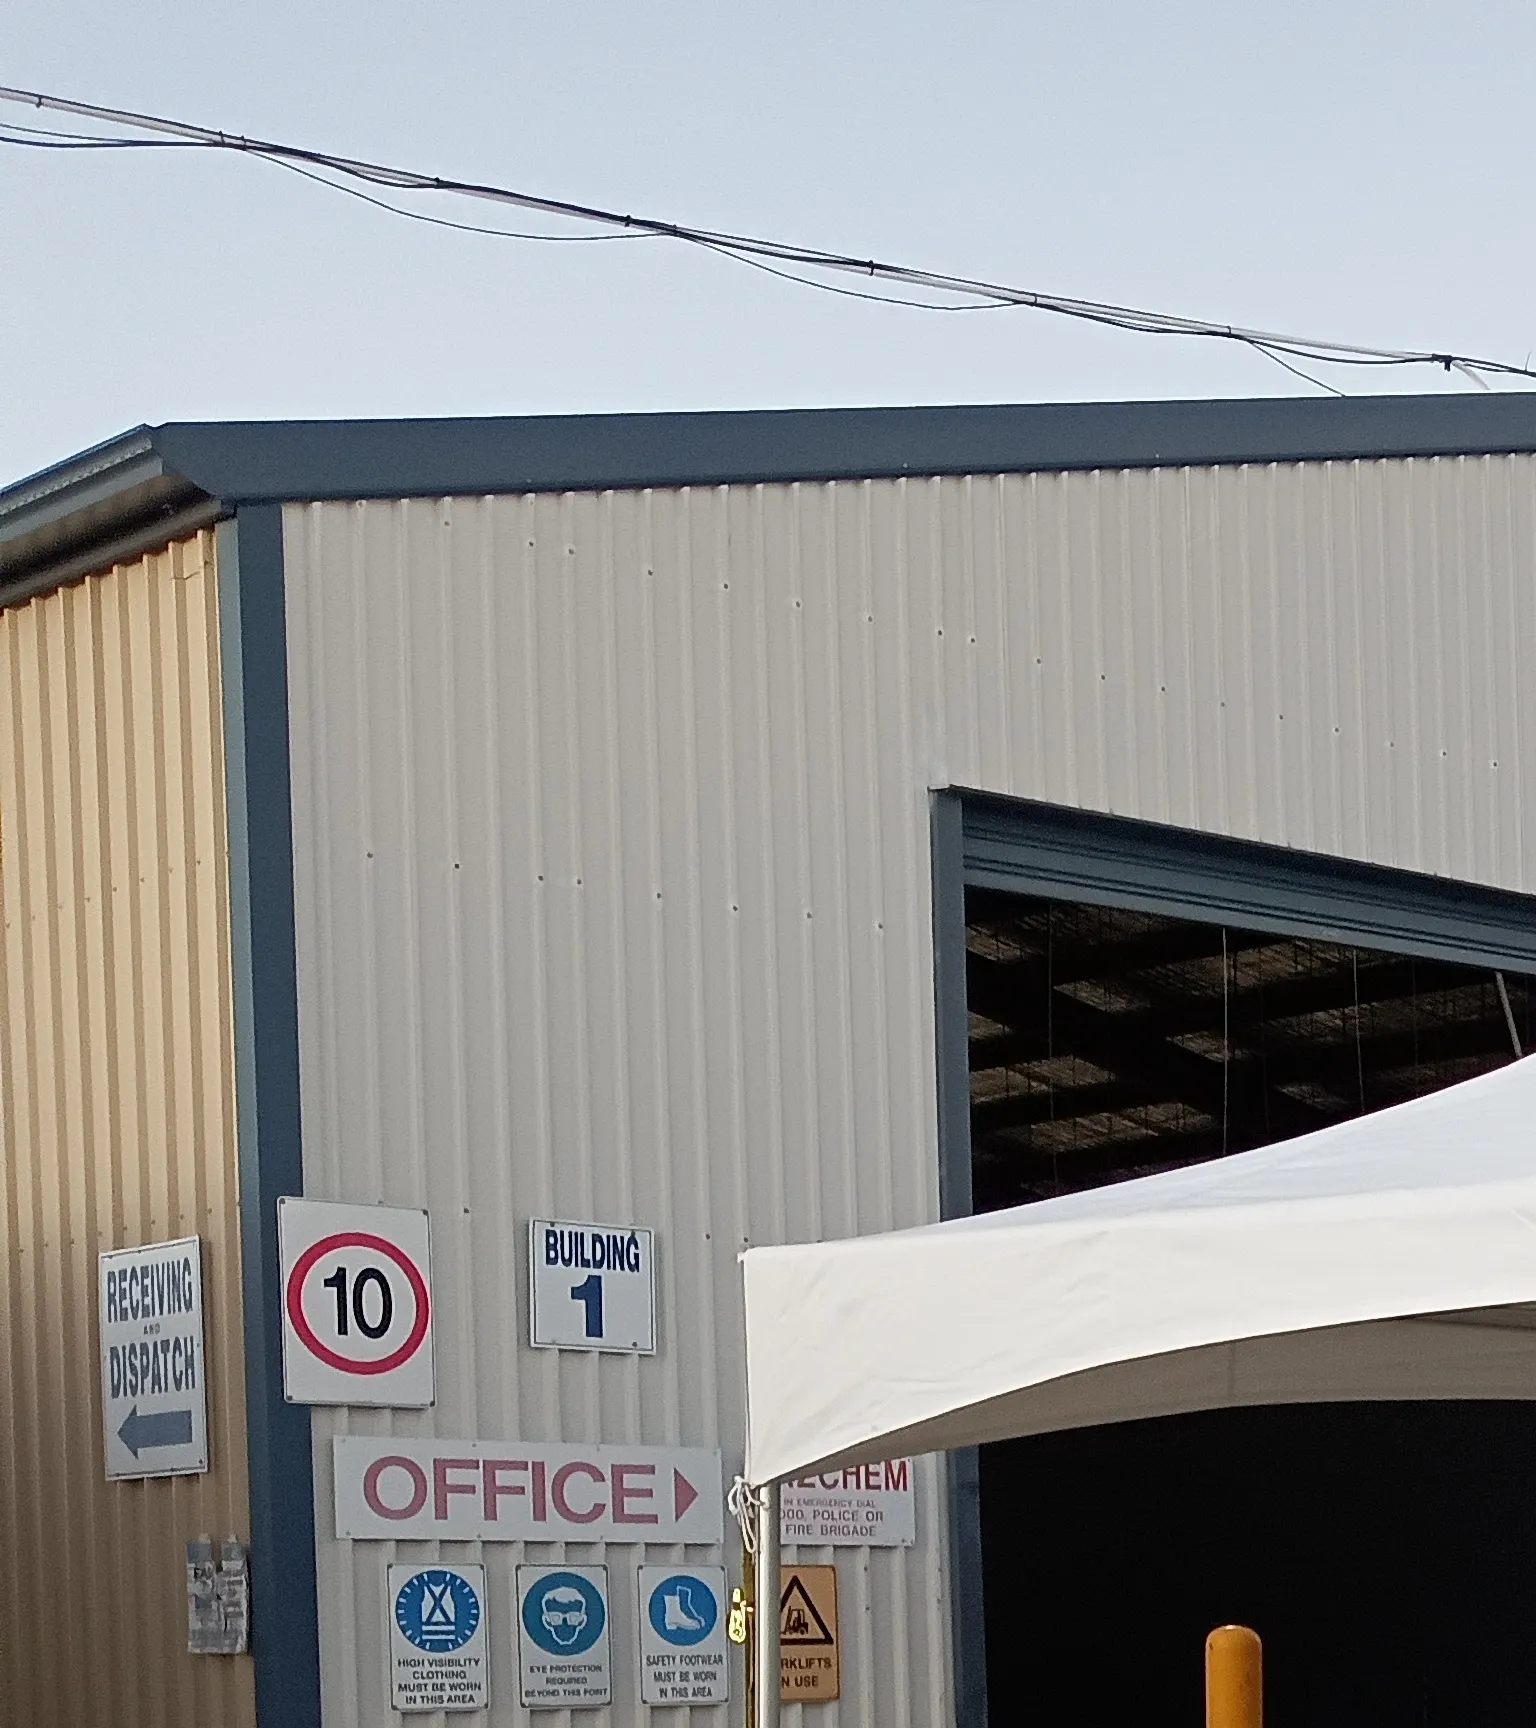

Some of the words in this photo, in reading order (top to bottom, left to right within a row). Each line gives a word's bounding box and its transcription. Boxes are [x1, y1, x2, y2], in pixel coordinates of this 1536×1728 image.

[545, 1229, 640, 1273] BUILDING
[107, 1257, 193, 1323] RECEIVING
[323, 1266, 393, 1339] 10
[570, 1275, 603, 1338] 1
[143, 1322, 161, 1335] AND
[110, 1335, 196, 1399] DISPATCH
[786, 1460, 908, 1492] CHEM
[363, 1455, 659, 1524] OFFICE
[797, 1499, 852, 1507] EMERGENCY
[856, 1500, 876, 1508] DIAL
[813, 1509, 859, 1522] POLICE
[866, 1511, 883, 1522] OR
[786, 1525, 813, 1535] FIRE
[820, 1525, 877, 1537] BRIGADE
[397, 1658, 425, 1668] HIGH
[427, 1657, 480, 1668] VISIBILITY
[646, 1654, 676, 1667] SAFETY
[680, 1653, 724, 1667] FOOTWEAR
[781, 1657, 832, 1670] RKLIFTS
[412, 1670, 467, 1680] CLOTHING
[529, 1665, 547, 1674] EYE
[549, 1664, 602, 1673] PROTECTION
[653, 1670, 676, 1683] MUST
[679, 1670, 690, 1682] BE
[693, 1670, 717, 1681] WORN
[781, 1676, 790, 1688] N
[795, 1675, 818, 1687] USE
[398, 1682, 428, 1693] MUST
[431, 1682, 446, 1692] BE
[449, 1681, 482, 1692] WORN
[659, 1687, 668, 1698] IN
[671, 1686, 689, 1698] THIS
[691, 1685, 713, 1697] AREA
[405, 1695, 417, 1704] IN
[420, 1694, 445, 1704] THIS
[446, 1693, 476, 1703] AREA
